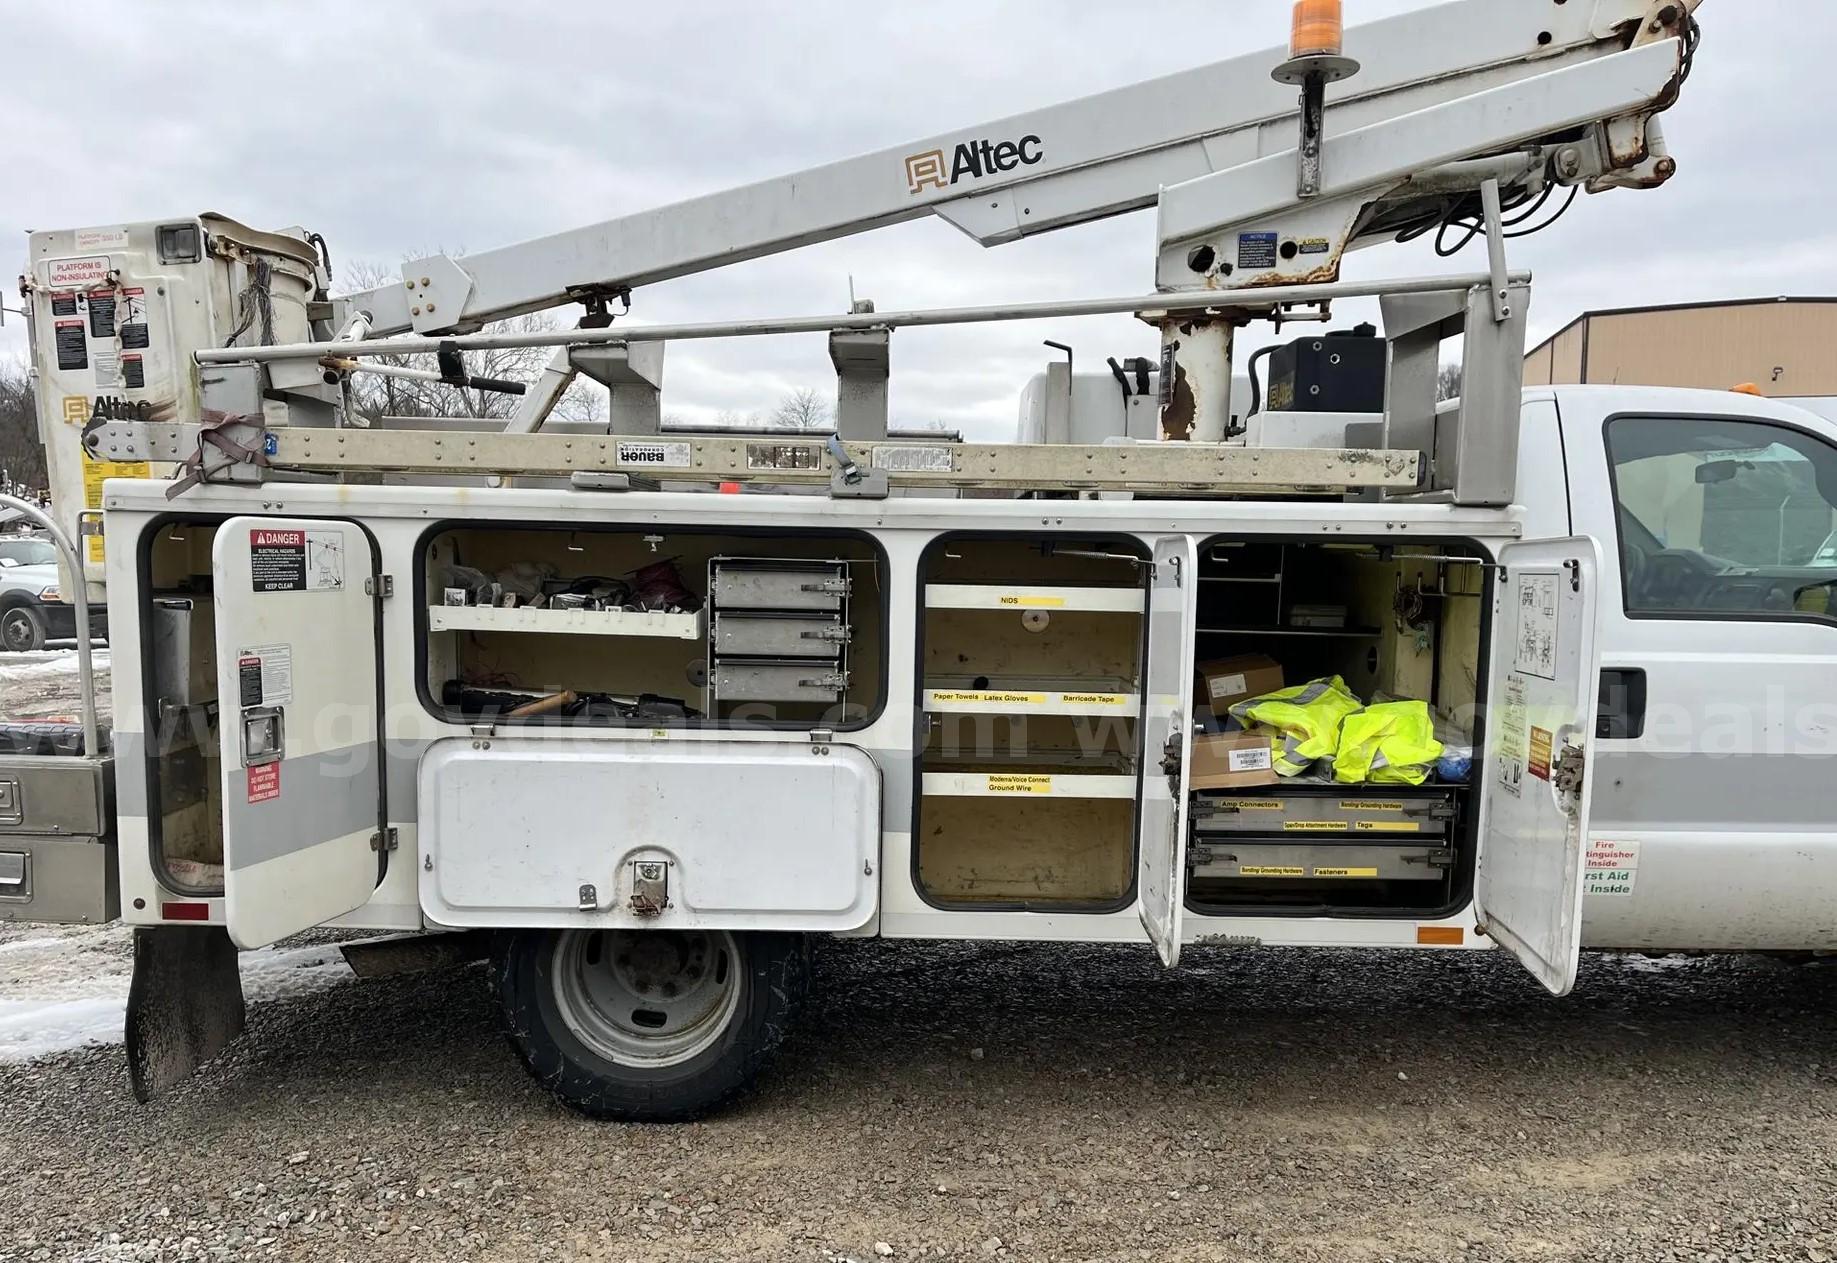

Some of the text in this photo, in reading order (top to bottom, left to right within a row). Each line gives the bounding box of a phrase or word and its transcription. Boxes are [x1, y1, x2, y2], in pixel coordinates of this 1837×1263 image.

[950, 135, 1043, 184] Altec
[57, 263, 93, 271] PLATFORM
[266, 533, 300, 544] DANGER
[1595, 841, 1615, 849] Fire
[1586, 850, 1635, 859] tinguisher
[1587, 859, 1618, 867] Inside
[1585, 871, 1629, 880] rst Aid
[1590, 884, 1630, 893] Inside
